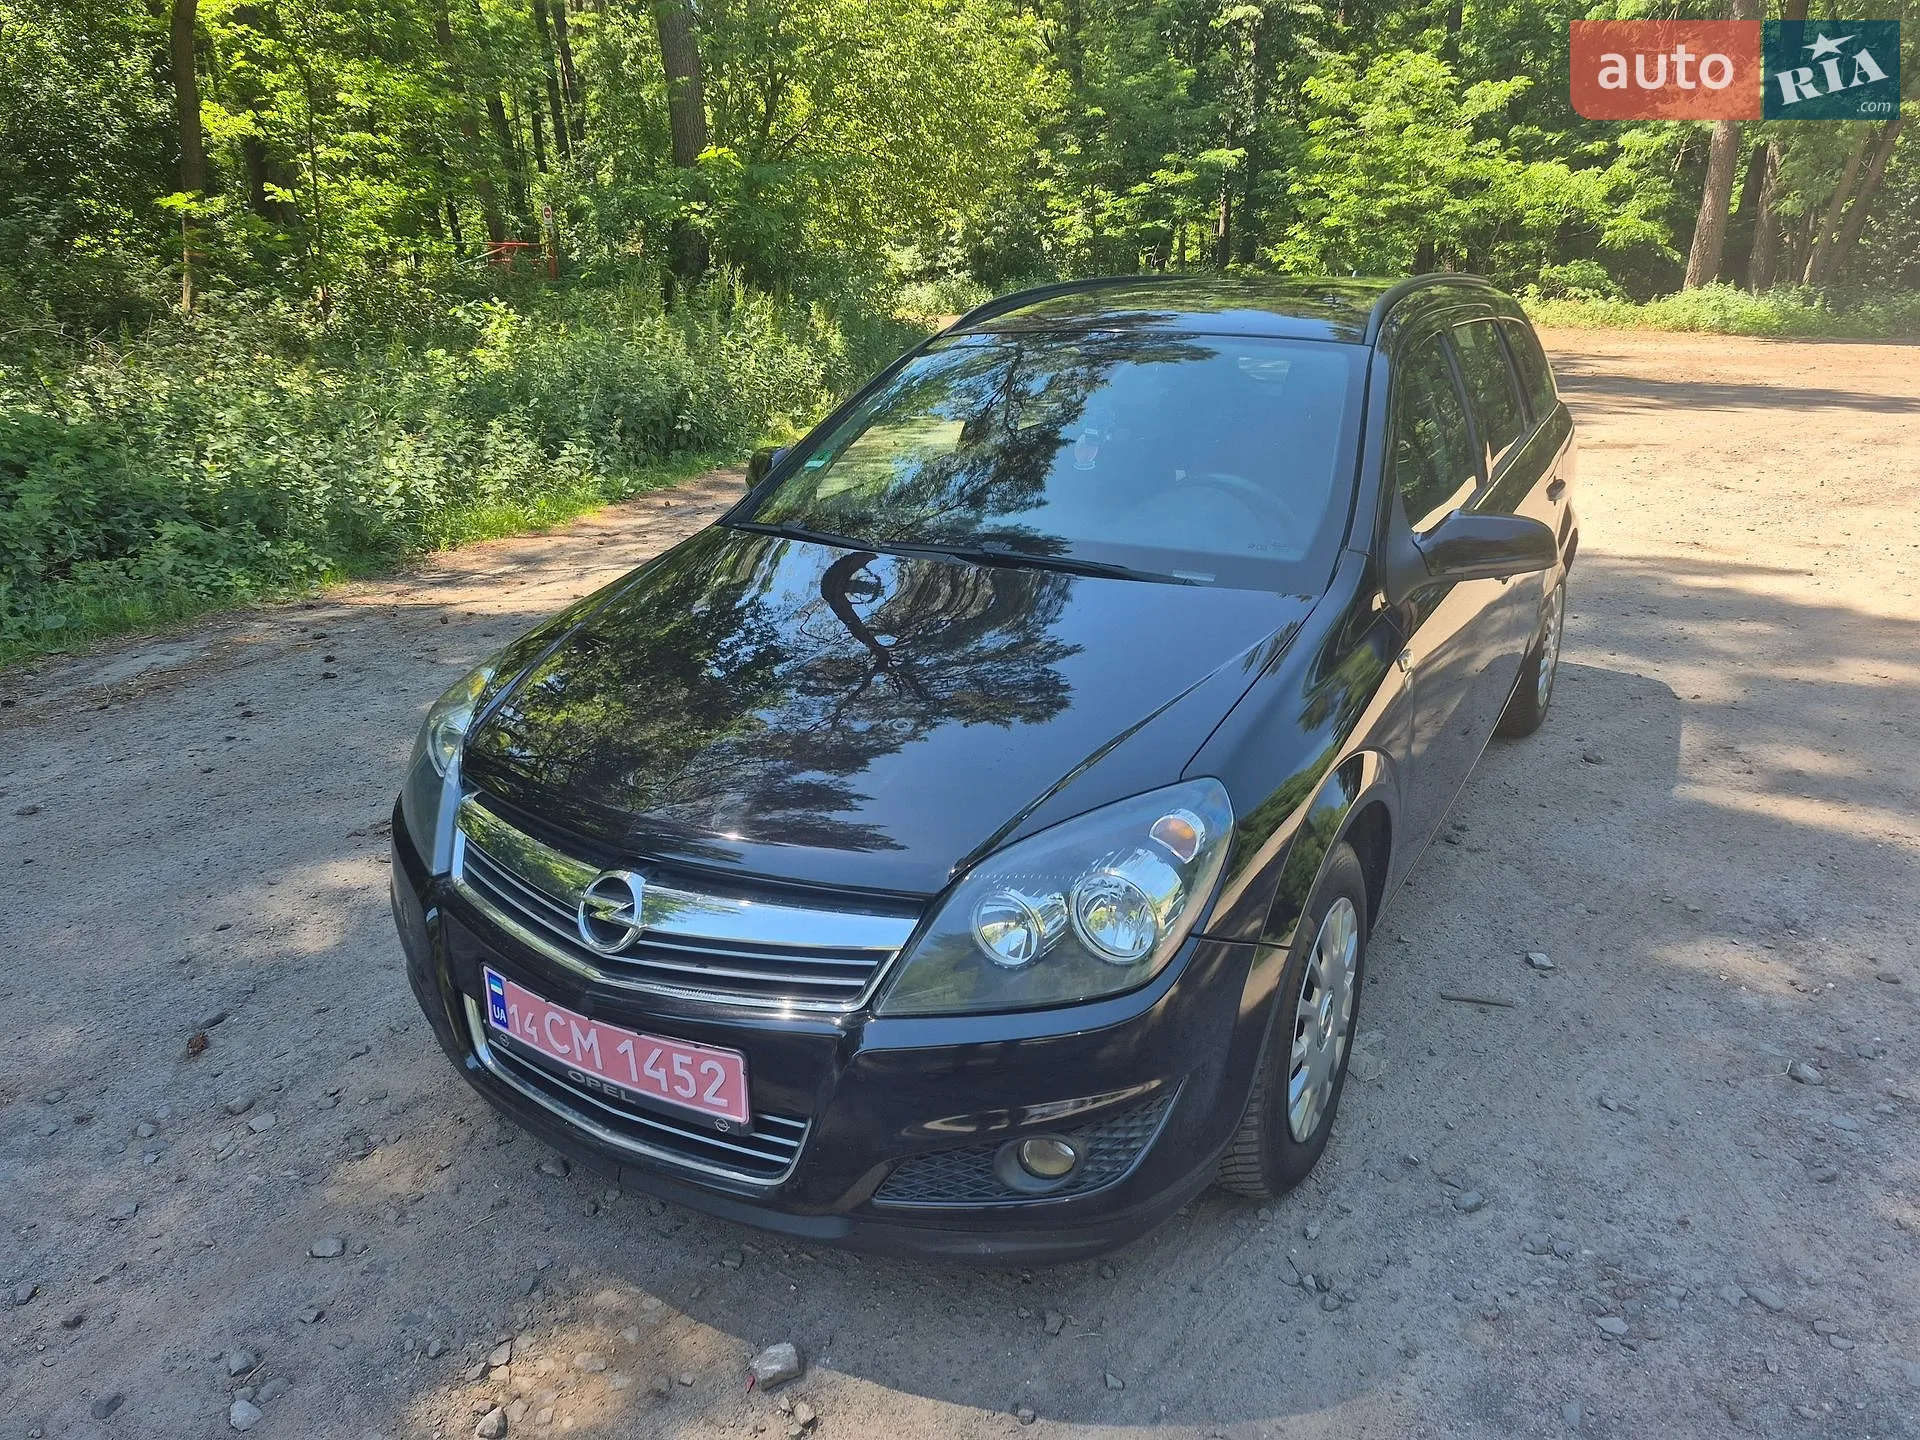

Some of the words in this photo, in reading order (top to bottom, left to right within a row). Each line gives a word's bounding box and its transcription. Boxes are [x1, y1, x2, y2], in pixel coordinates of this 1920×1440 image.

[492, 1004, 507, 1023] UA
[567, 1070, 637, 1104] OPEL
[616, 1039, 728, 1107] 1452
